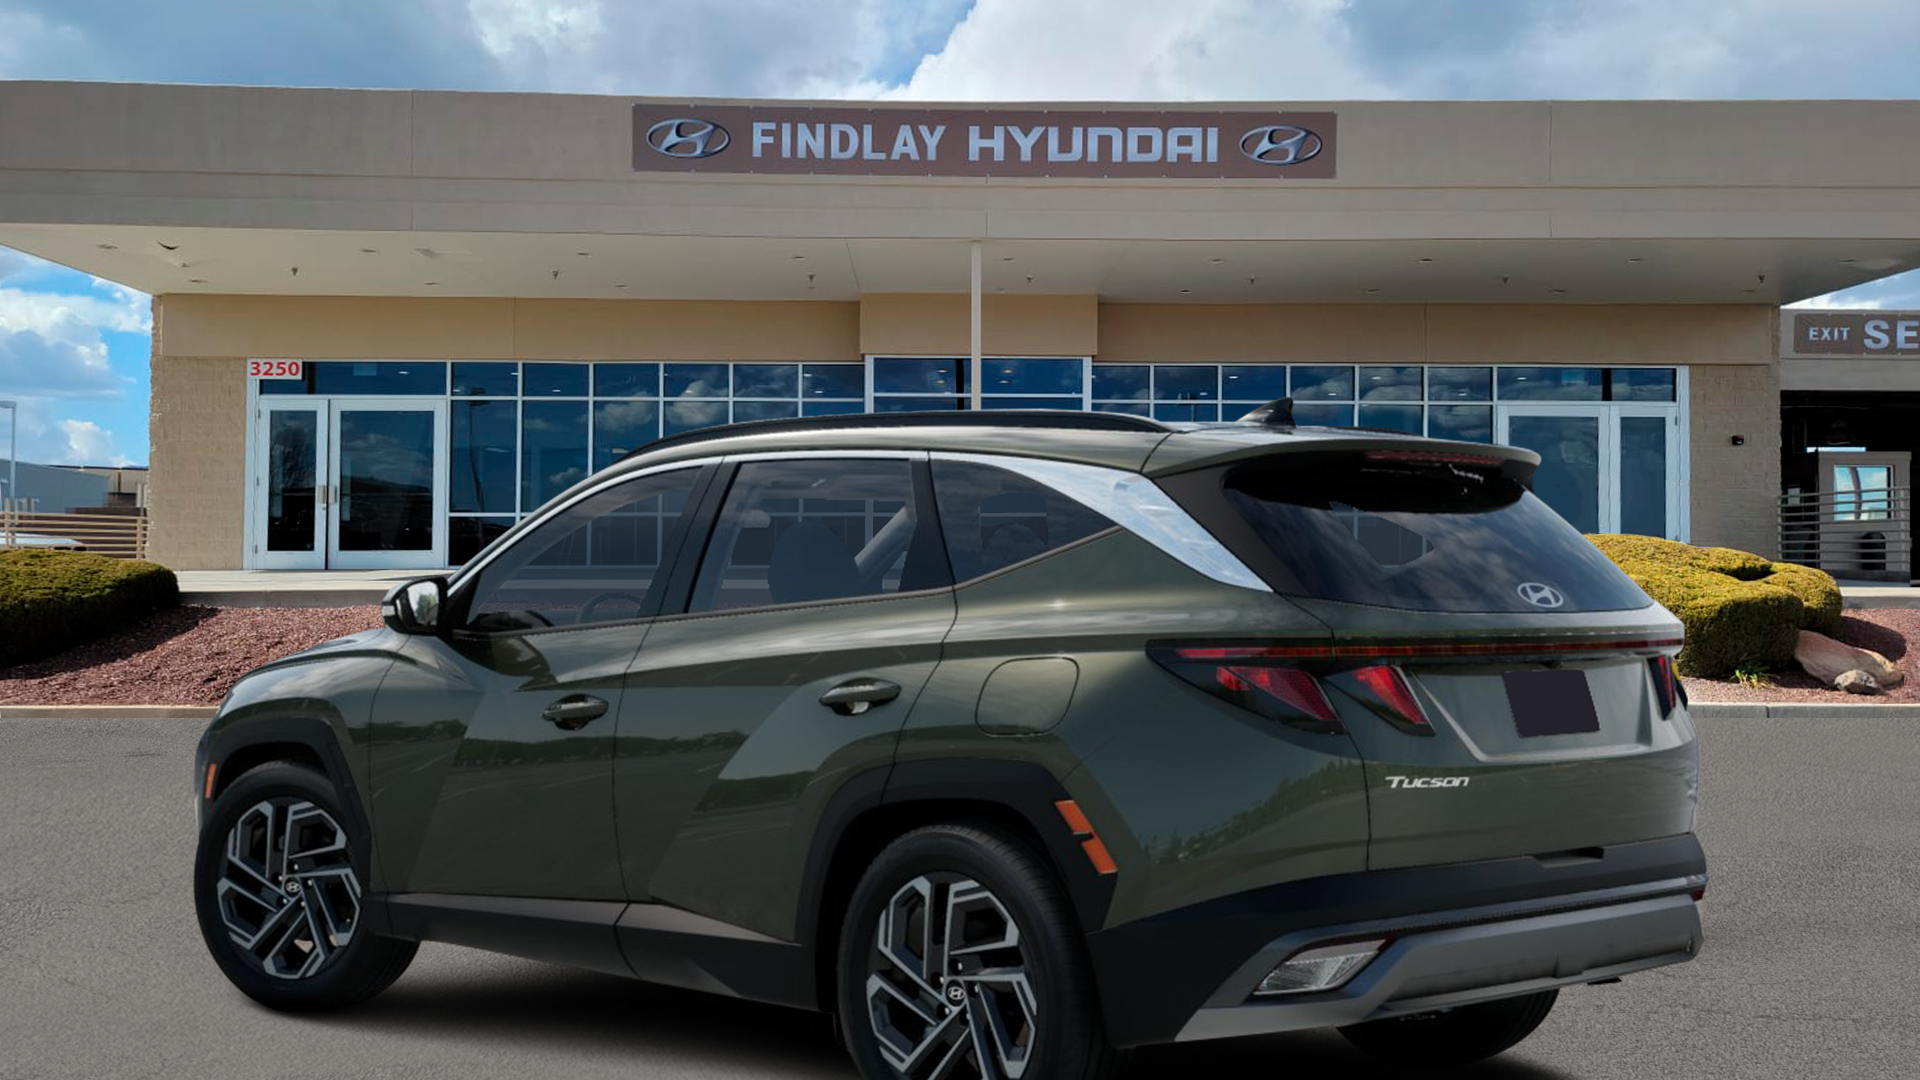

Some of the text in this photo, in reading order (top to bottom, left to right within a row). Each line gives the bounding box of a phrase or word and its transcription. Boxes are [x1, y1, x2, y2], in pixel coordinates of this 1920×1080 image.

[752, 122, 1218, 162] FINDLAY HYUNDAI
[1809, 327, 1850, 341] EXIT
[250, 361, 300, 376] 3250
[1385, 776, 1469, 788] Tucson
